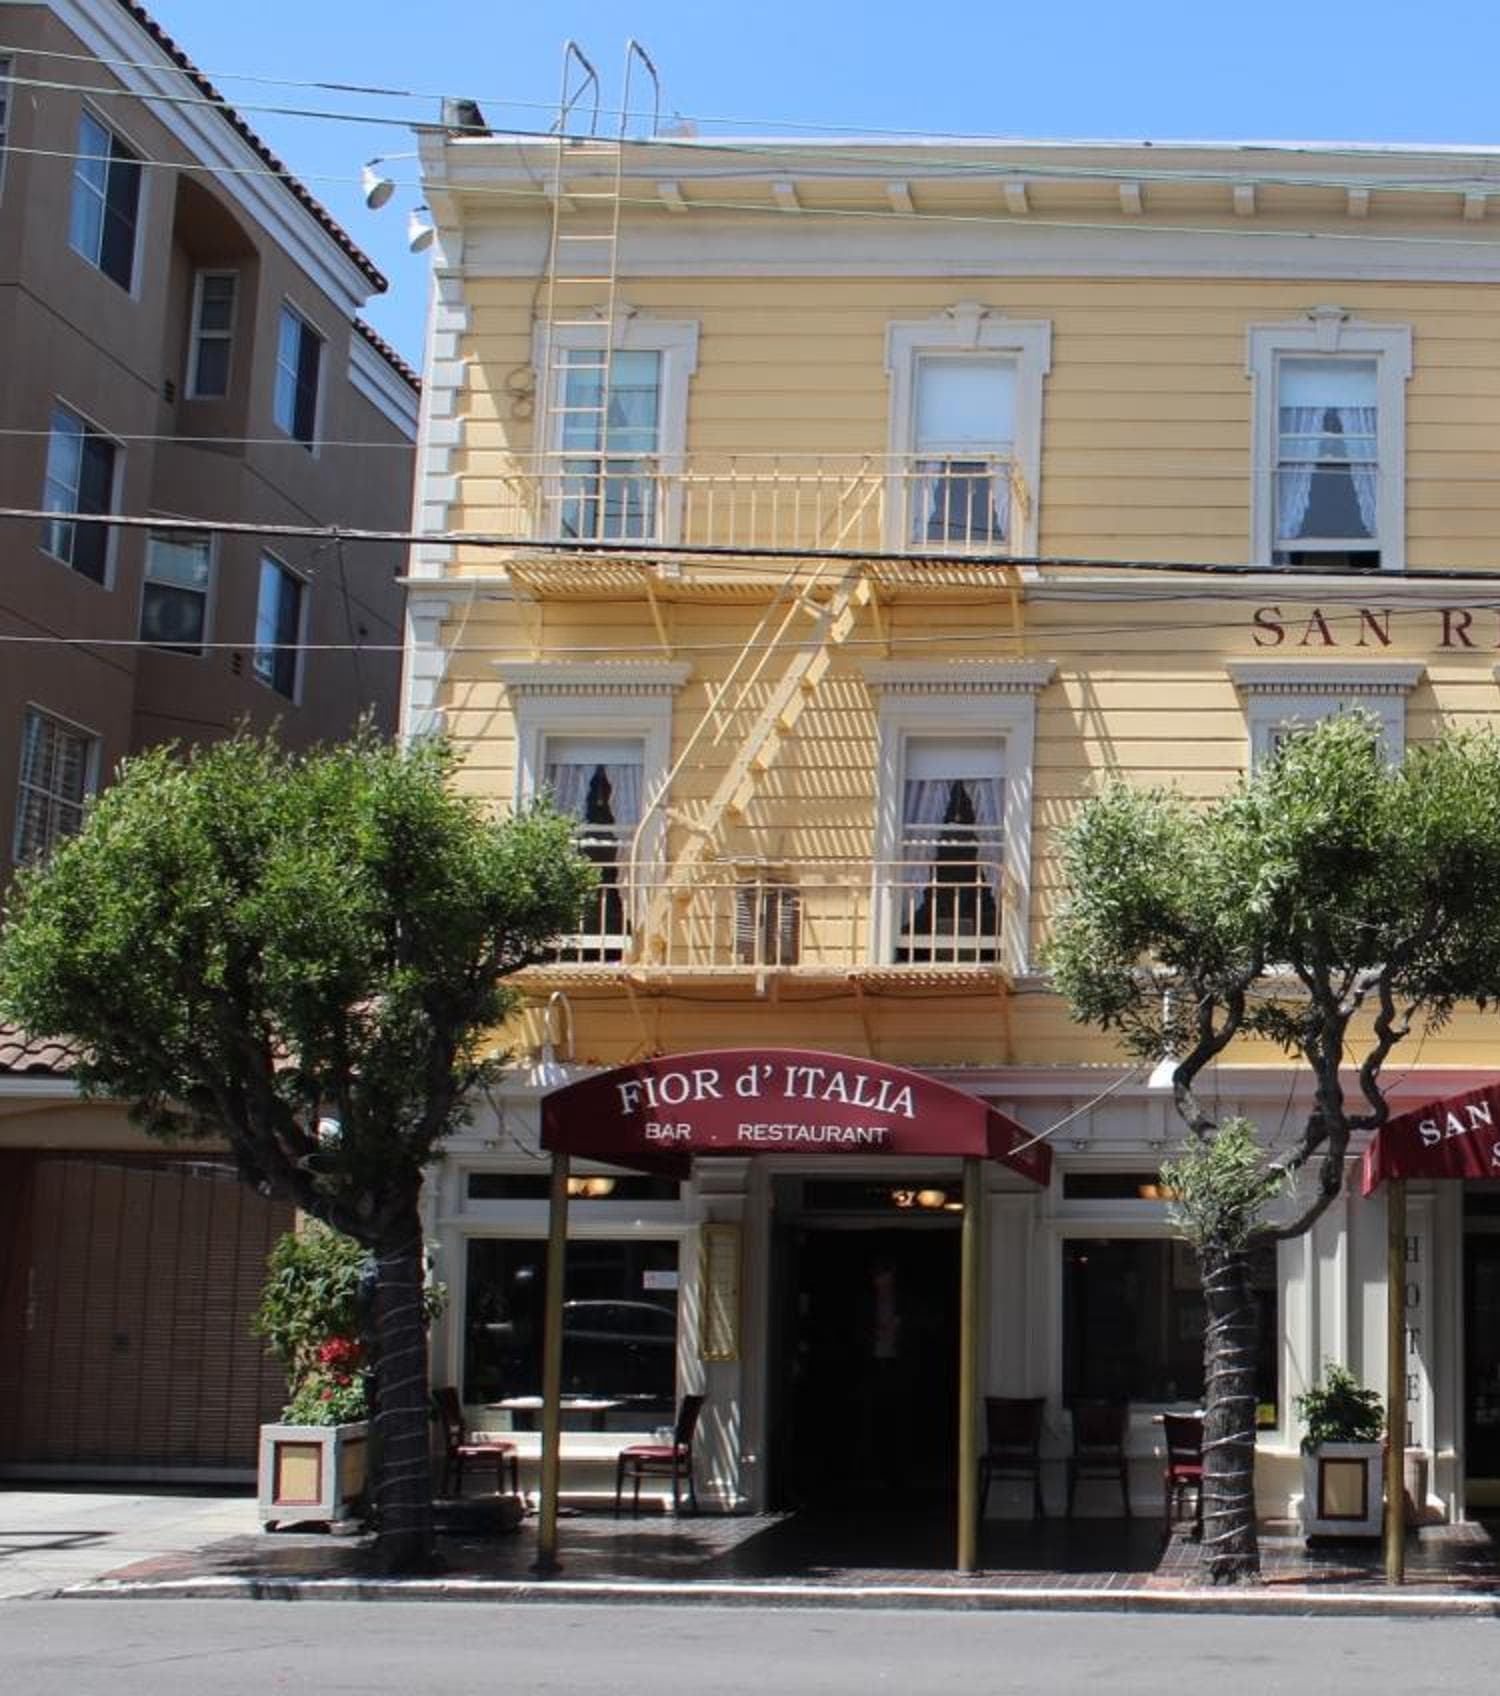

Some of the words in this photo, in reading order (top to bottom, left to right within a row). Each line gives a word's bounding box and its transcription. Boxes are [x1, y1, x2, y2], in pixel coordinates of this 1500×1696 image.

[1252, 606, 1393, 648] SAN
[618, 1070, 722, 1116] FIOR
[784, 1067, 916, 1119] ITALIA
[645, 1124, 692, 1142] BAR
[739, 1125, 889, 1144] RESTAURANT
[1419, 1101, 1493, 1146] SAN
[1403, 1236, 1421, 1447] HOTEL
